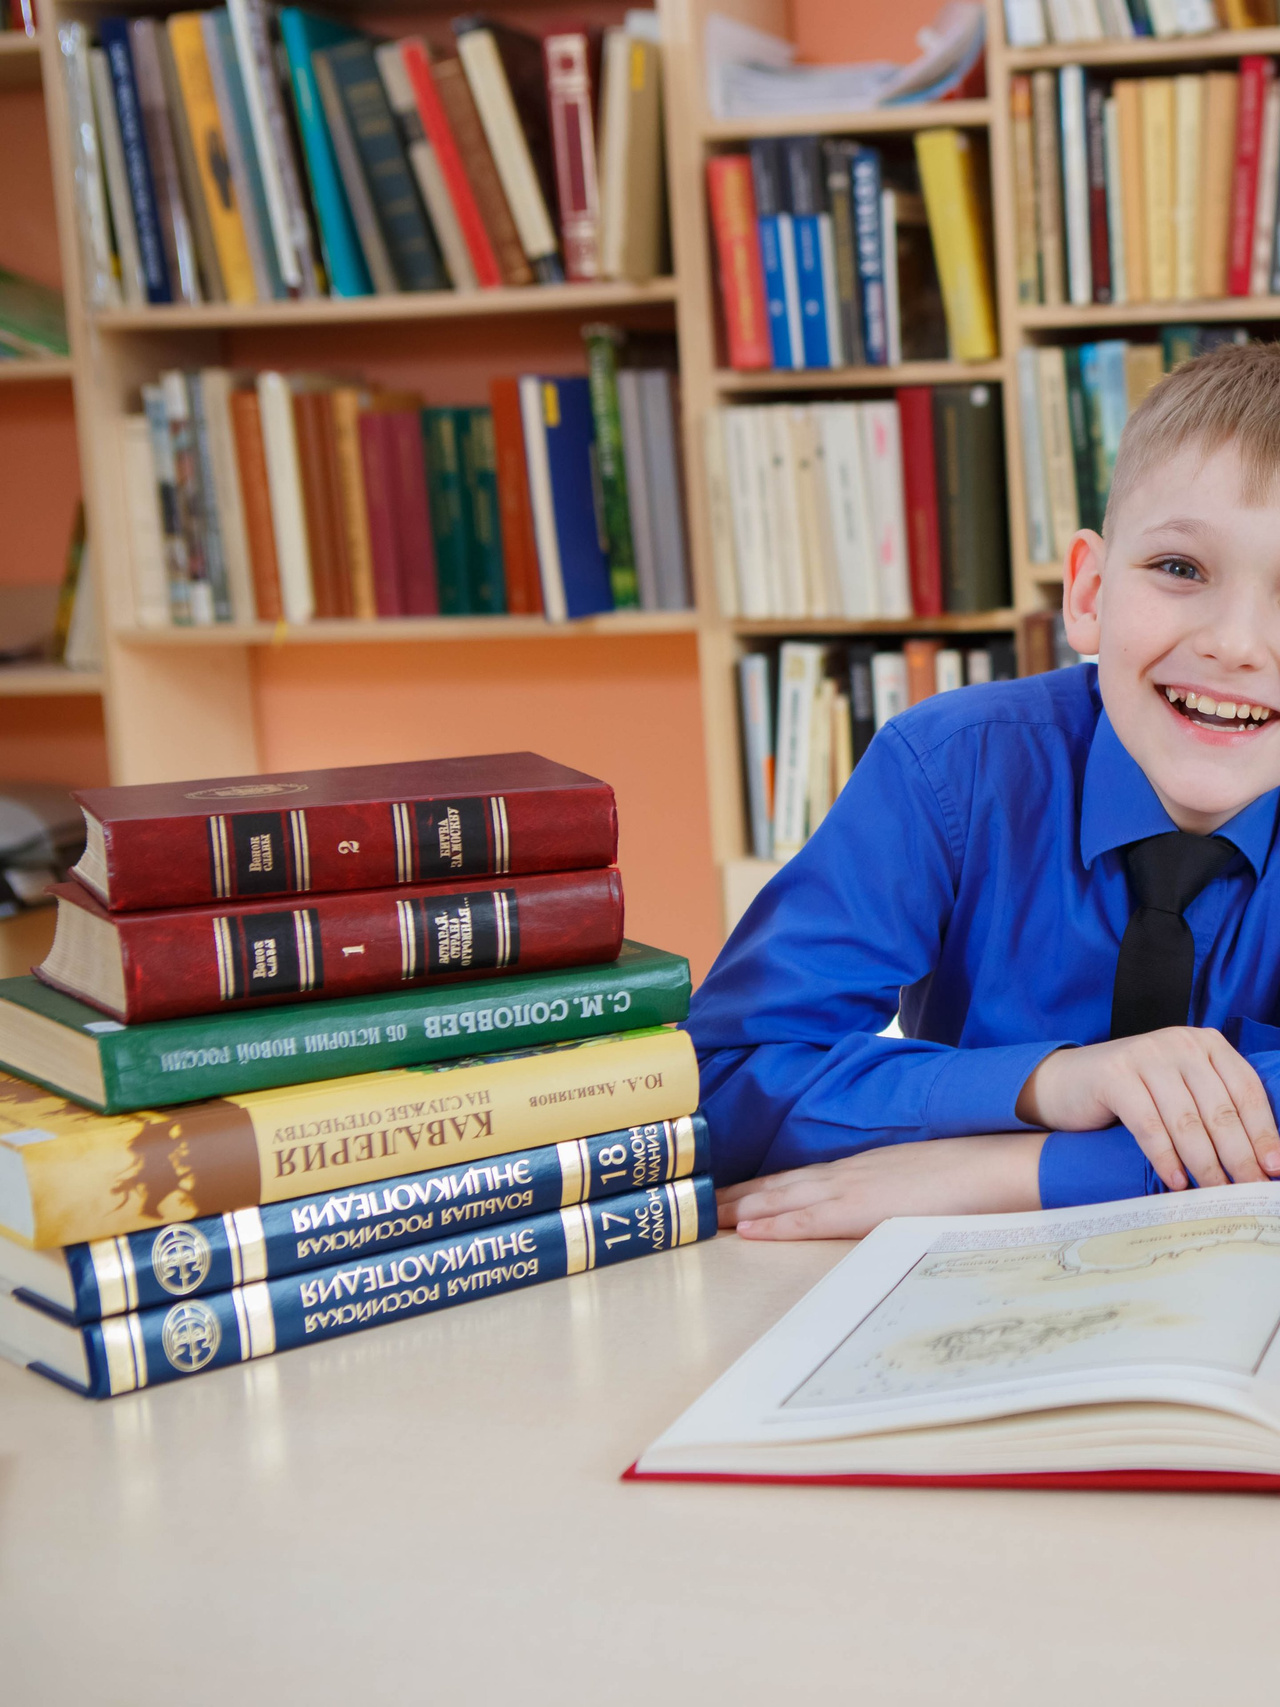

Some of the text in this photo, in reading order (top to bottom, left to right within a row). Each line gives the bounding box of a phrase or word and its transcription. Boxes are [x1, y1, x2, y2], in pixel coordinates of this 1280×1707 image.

[337, 840, 360, 855] 2
[438, 818, 451, 858] БИТВА
[447, 806, 462, 868] ЗА МОСКВУ
[341, 944, 365, 957] 1
[449, 917, 461, 959] СТРАНА
[386, 1022, 408, 1042] ОБ
[424, 999, 569, 1039] СОЛОВЬЕВ
[160, 1045, 231, 1073] РОССИИ
[236, 1037, 297, 1065] НОВОЙ
[304, 1027, 380, 1053] ИСТОРИИ
[272, 1089, 491, 1145] НА СЛУЖБЕ ОТЕЧЕСТВУ
[274, 1109, 495, 1179] КАВАЛЕРИЯ
[598, 1144, 628, 1185] 18
[628, 1126, 647, 1187] ЛОМОН
[644, 1124, 662, 1183] МАНИЗ
[290, 1158, 533, 1234] ЭНЦИКЛОПЕДИЯ
[296, 1189, 534, 1259] БОЛЬШАЯ РОССИЙСКАЯ
[601, 1211, 631, 1250] 17
[635, 1206, 650, 1239] ЛАС
[646, 1187, 665, 1251] ЛОМОН
[299, 1228, 537, 1308] ЭНЦИКЛОПЕДИЯ
[304, 1258, 540, 1334] БОЛЬШАЯ РОССИЙСКАЯ
